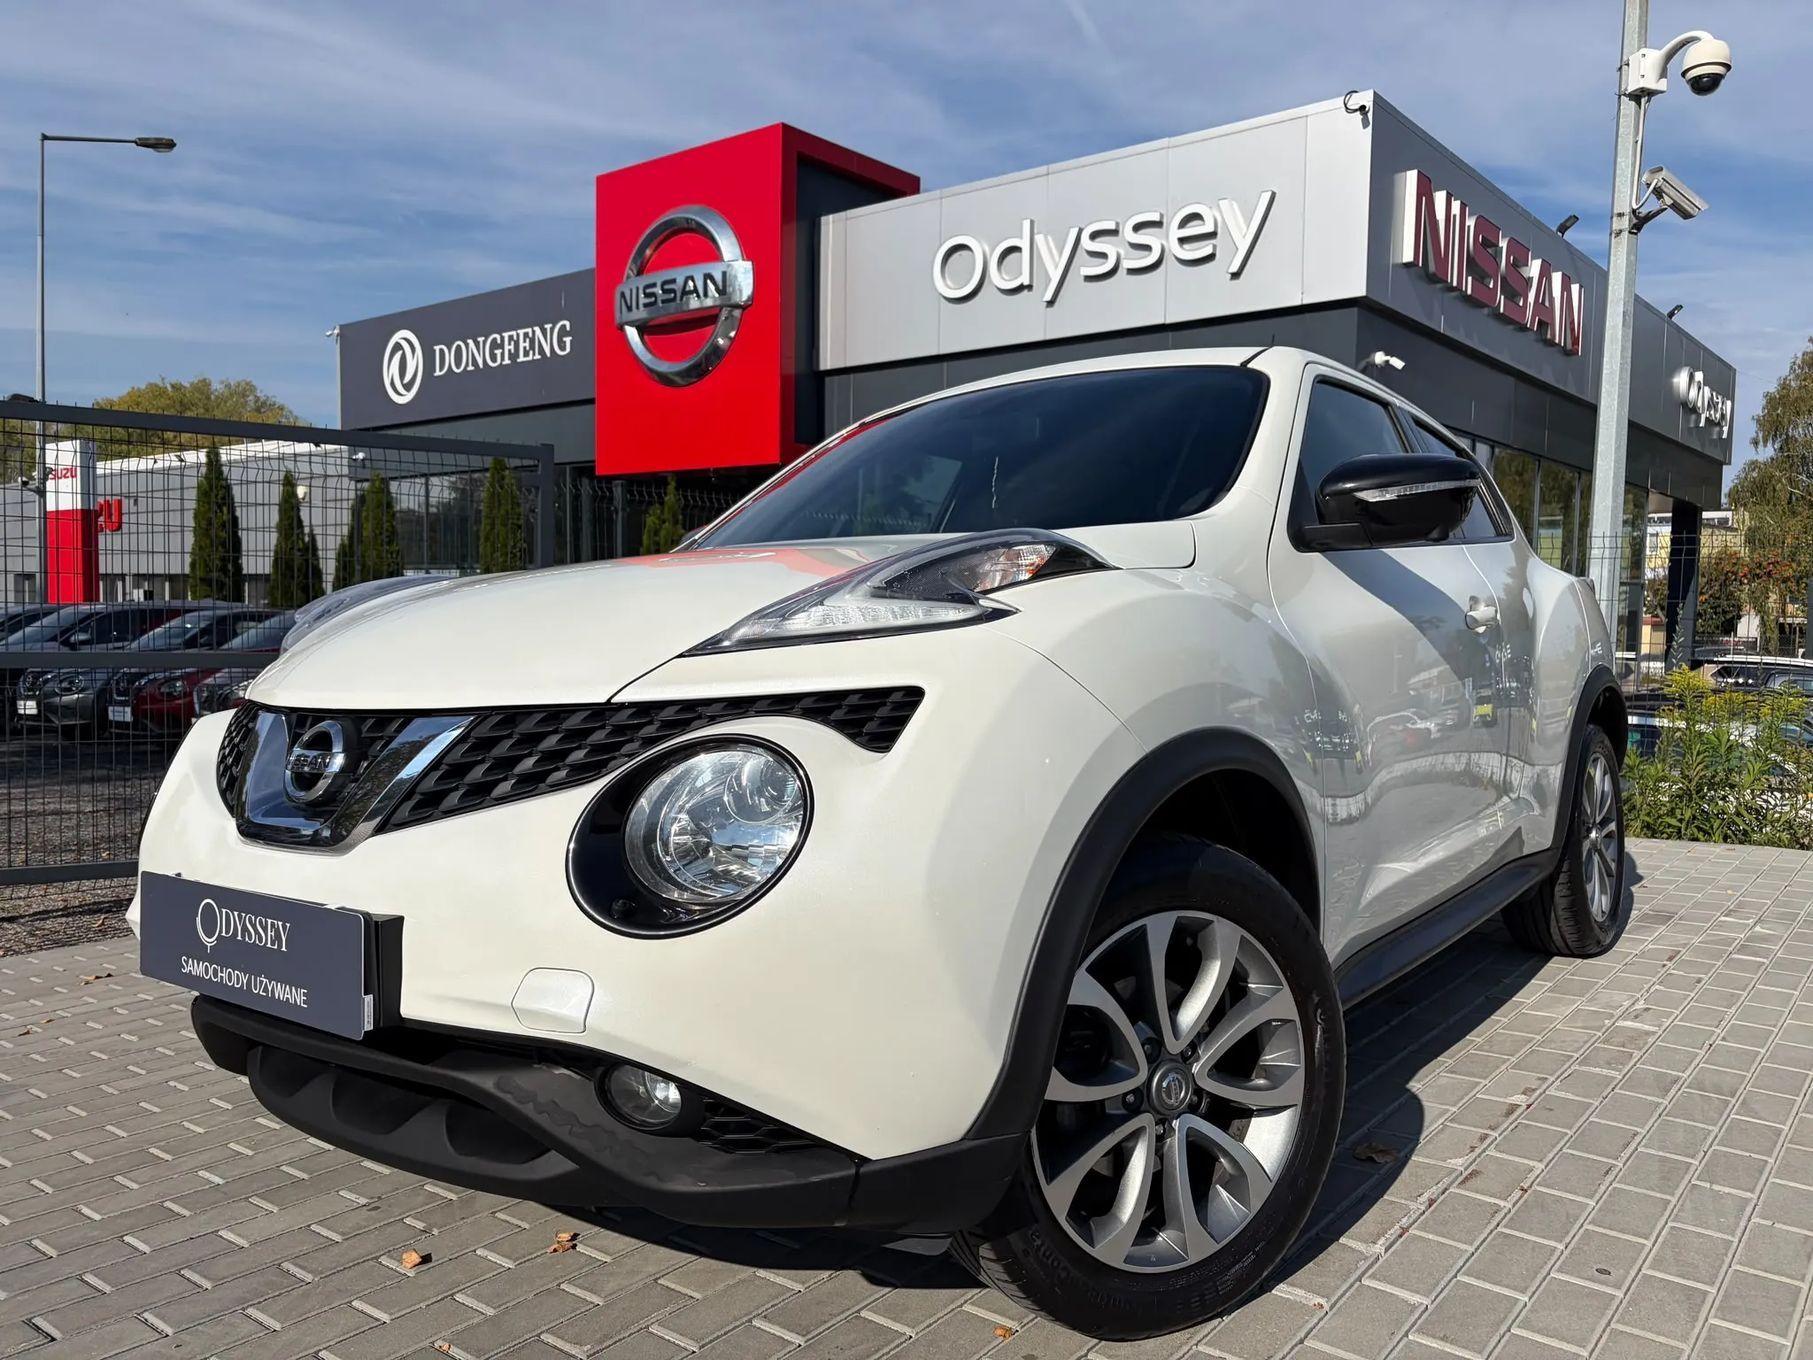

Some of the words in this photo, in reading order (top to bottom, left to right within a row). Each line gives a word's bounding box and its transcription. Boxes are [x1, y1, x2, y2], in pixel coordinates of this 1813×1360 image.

[932, 189, 1277, 305] Odyssey
[1401, 168, 1585, 356] NISSAN
[618, 270, 728, 314] NISSAN
[432, 319, 573, 377] DONGFENG
[48, 467, 78, 481] SUZU
[196, 898, 291, 953] ODYSSEY
[181, 956, 249, 990] SAMOCHODY
[251, 974, 308, 1008] UŻYWANE
